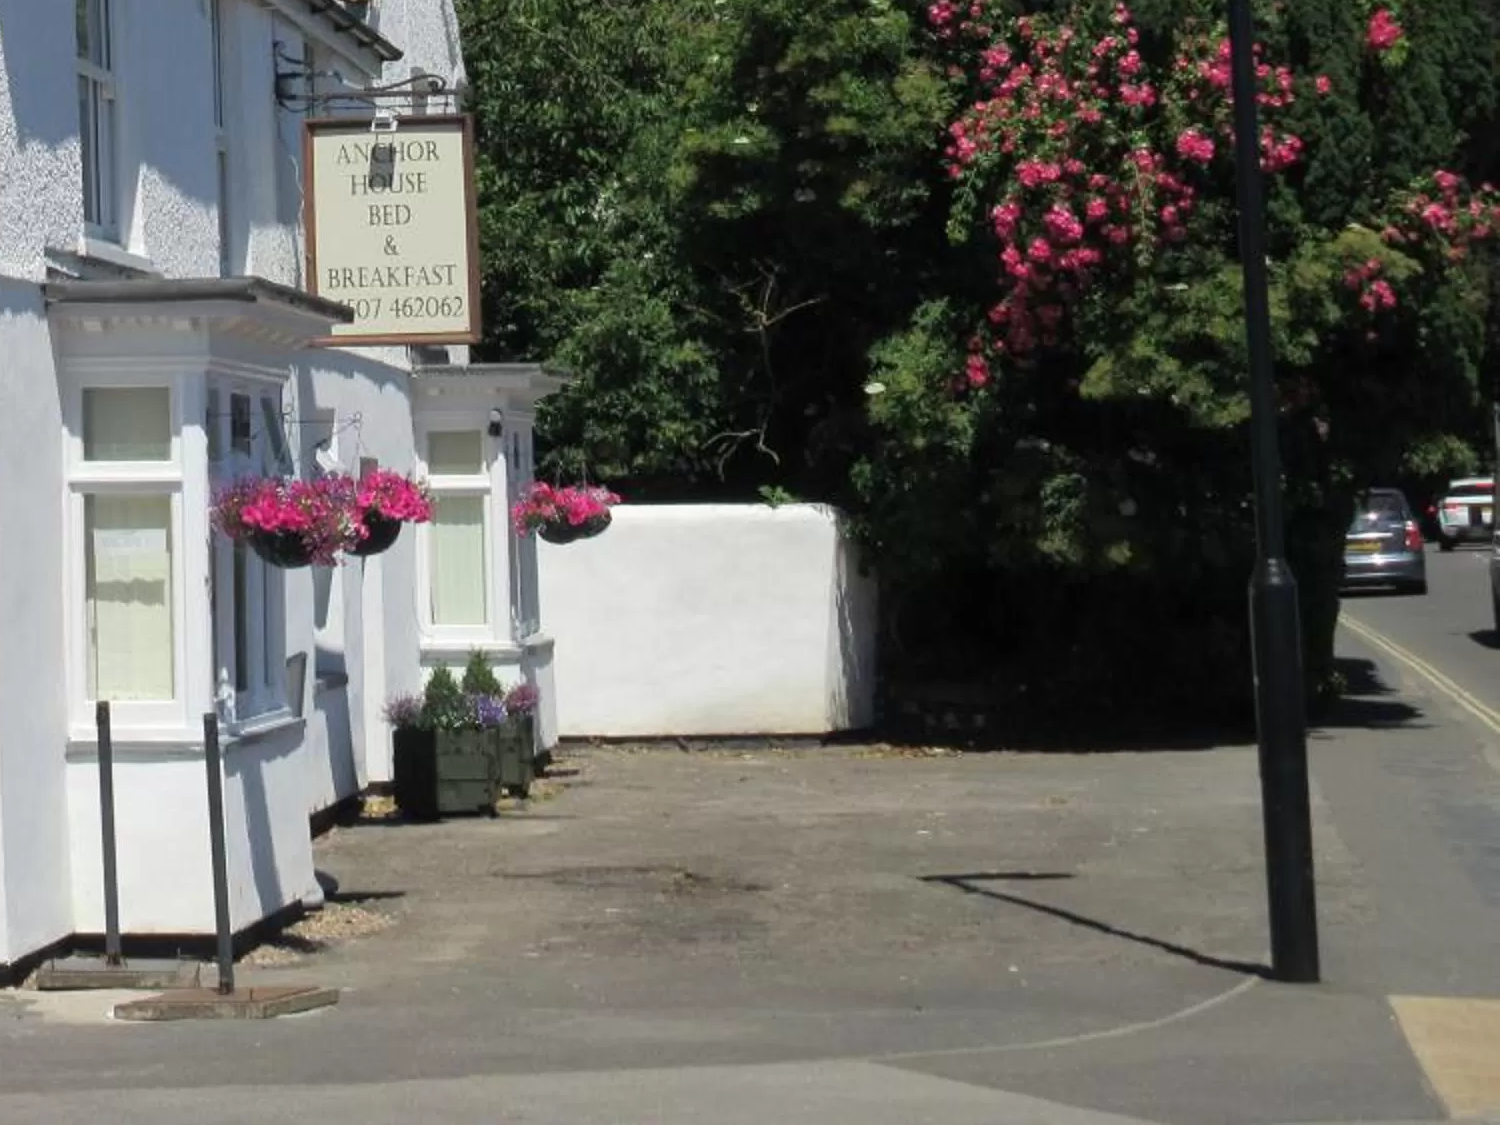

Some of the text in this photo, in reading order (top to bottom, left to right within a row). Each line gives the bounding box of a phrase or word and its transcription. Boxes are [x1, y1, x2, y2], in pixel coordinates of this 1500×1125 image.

[336, 140, 440, 165] ANCHOR
[350, 172, 428, 196] HOUSE
[368, 204, 412, 226] BED
[383, 235, 400, 256] &
[327, 265, 457, 290] BREAKFAST
[389, 296, 465, 320] 462062
